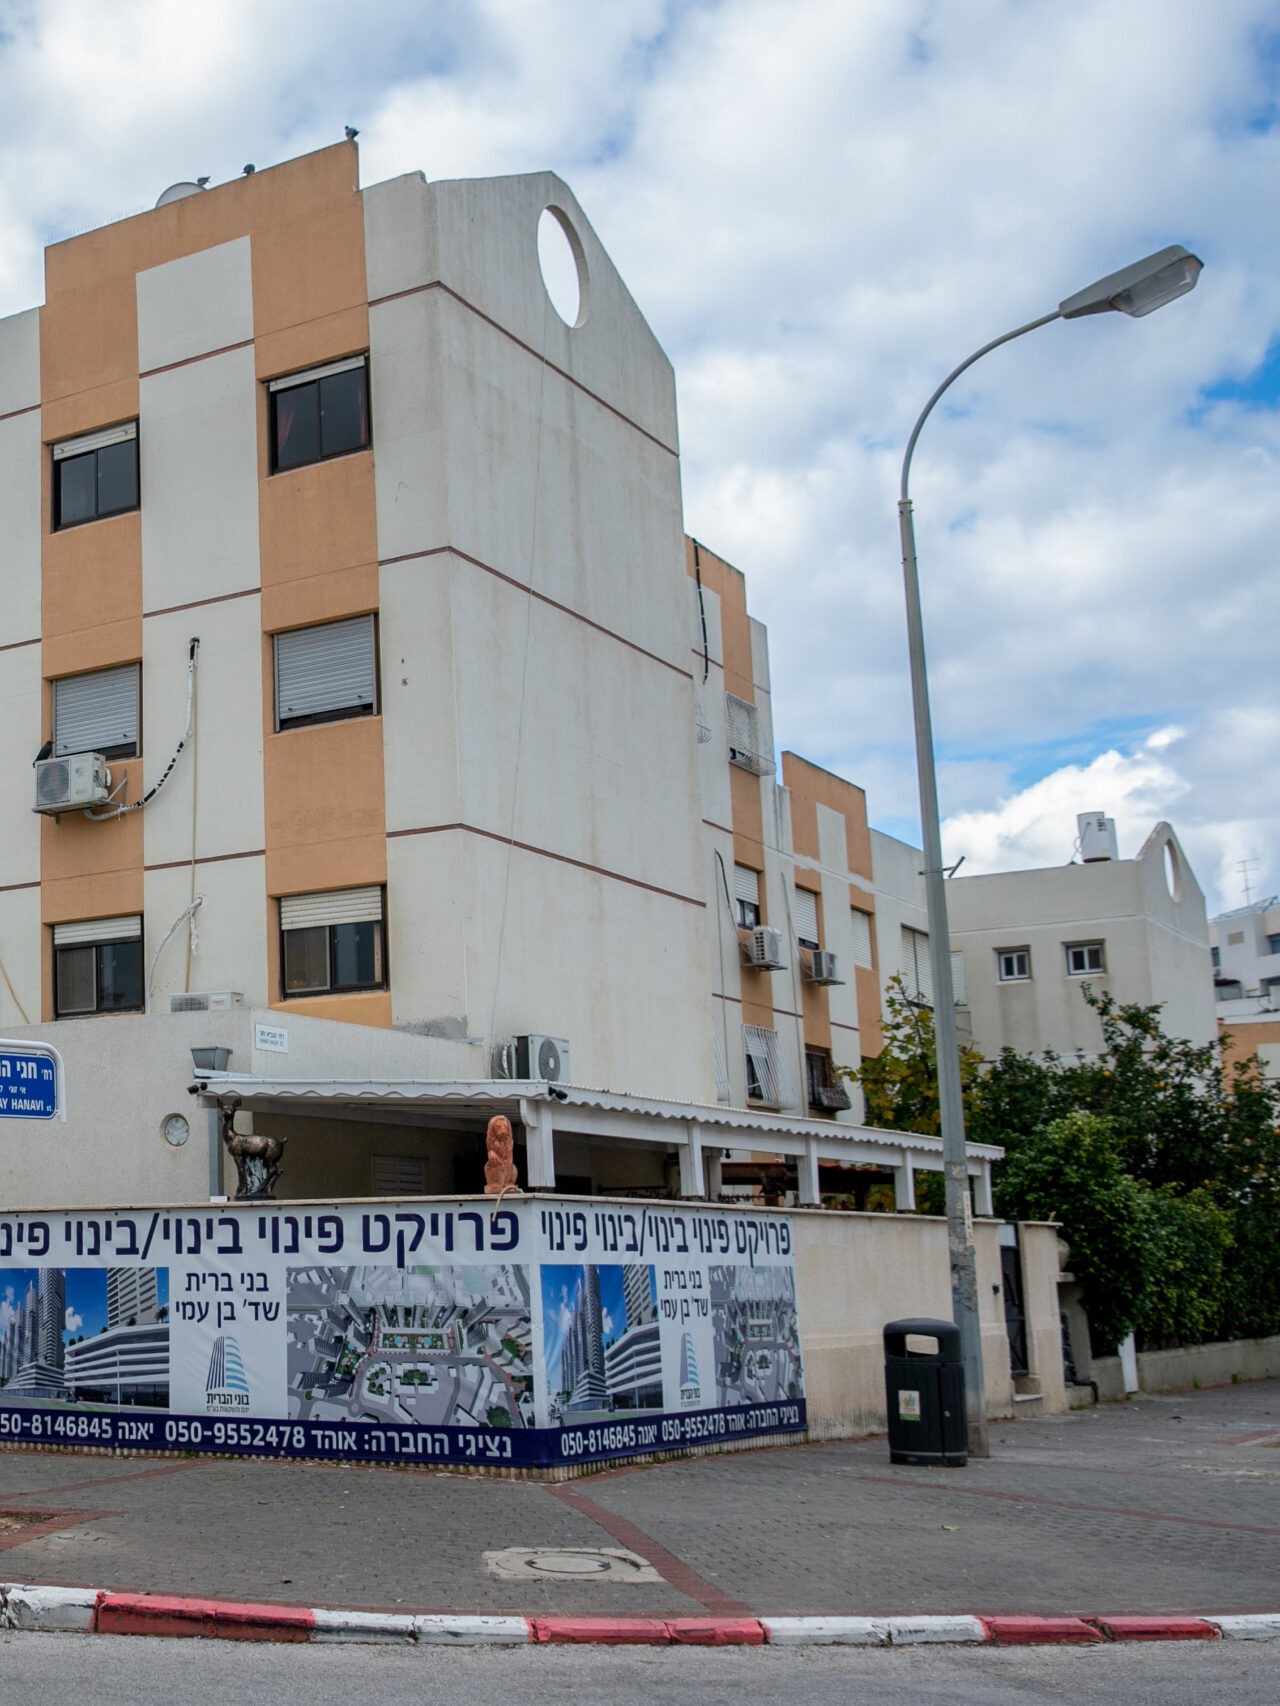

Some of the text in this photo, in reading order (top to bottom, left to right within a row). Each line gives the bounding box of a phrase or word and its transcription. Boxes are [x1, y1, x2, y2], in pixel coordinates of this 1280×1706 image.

[16, 1060, 38, 1080] חגי
[41, 1069, 53, 1080] רח'
[11, 1098, 44, 1111] HANAVI
[64, 1212, 244, 1260] בינוי/בינוי
[258, 1213, 344, 1254] פינוי
[362, 1210, 520, 1269] פרויקט
[540, 1209, 791, 1268] פרויקט פינוי בינוי/בינוי פינוי
[184, 1271, 270, 1293] בני ברית
[663, 1269, 703, 1290] בני ברית
[176, 1298, 281, 1329] שד' בן עמי
[660, 1299, 678, 1322] עמי
[681, 1298, 690, 1325] בן
[206, 1392, 250, 1406] בוני הברית
[117, 1420, 154, 1442] יאנה
[165, 1420, 306, 1448] 050-9552478
[311, 1428, 358, 1451] אוהד
[364, 1430, 449, 1456] החברה:
[560, 1405, 800, 1456] נציגי החברה: אוהד 050-9552478 יאנה 050-8146845
[458, 1432, 512, 1458] נציגי
